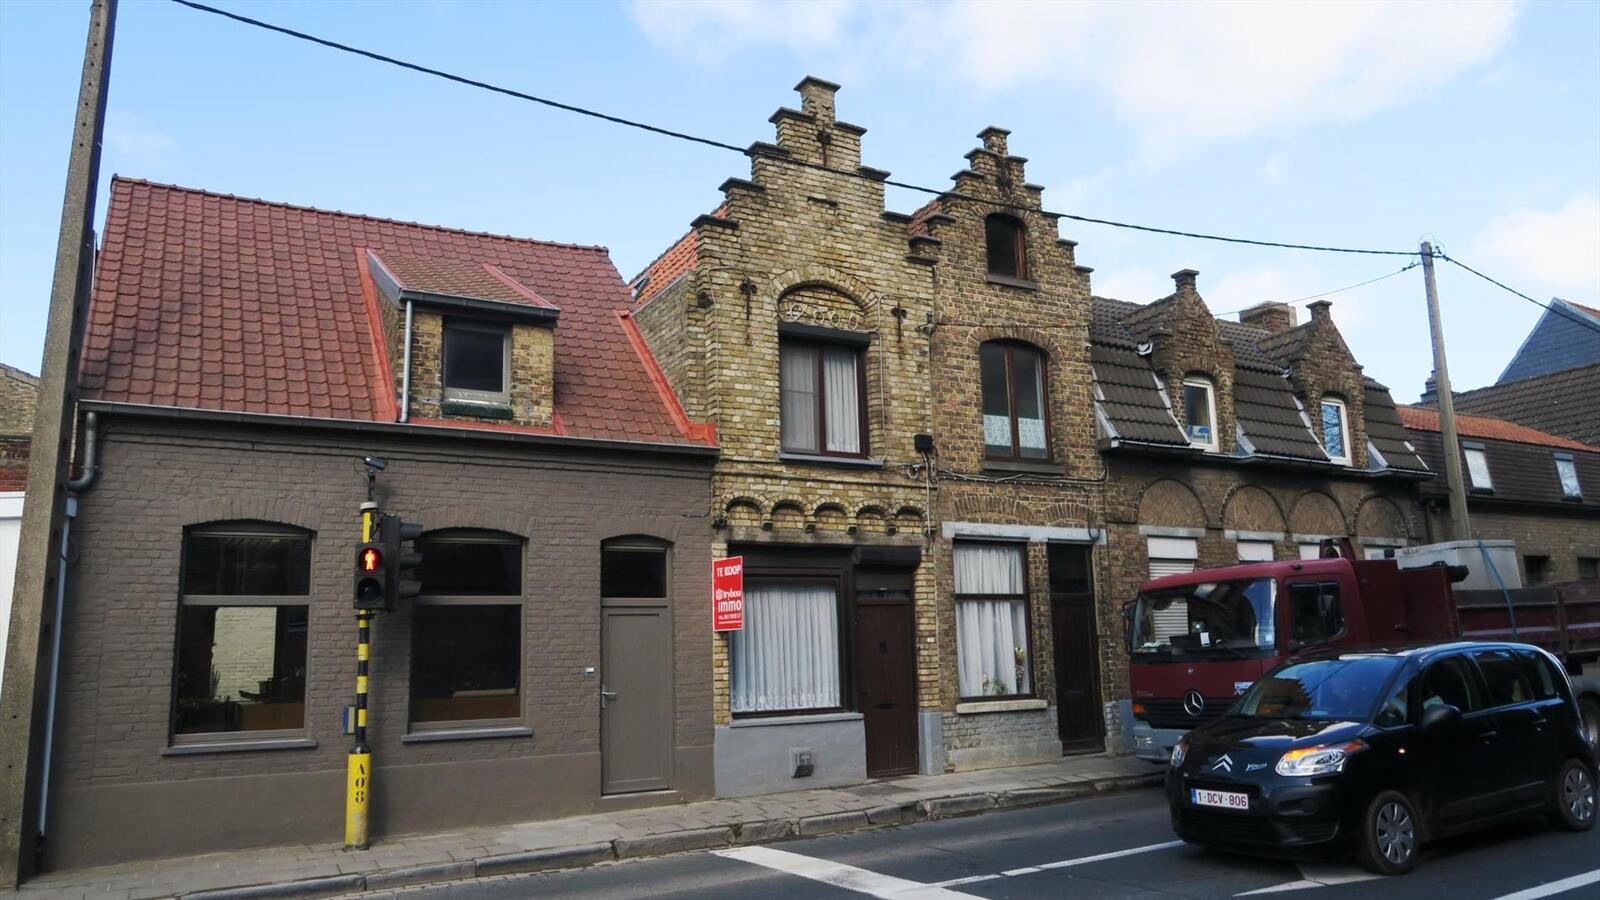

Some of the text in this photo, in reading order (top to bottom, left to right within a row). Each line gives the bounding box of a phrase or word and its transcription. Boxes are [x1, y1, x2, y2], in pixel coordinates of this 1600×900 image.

[716, 565, 741, 577] TE KOOP
[718, 600, 741, 612] immo
